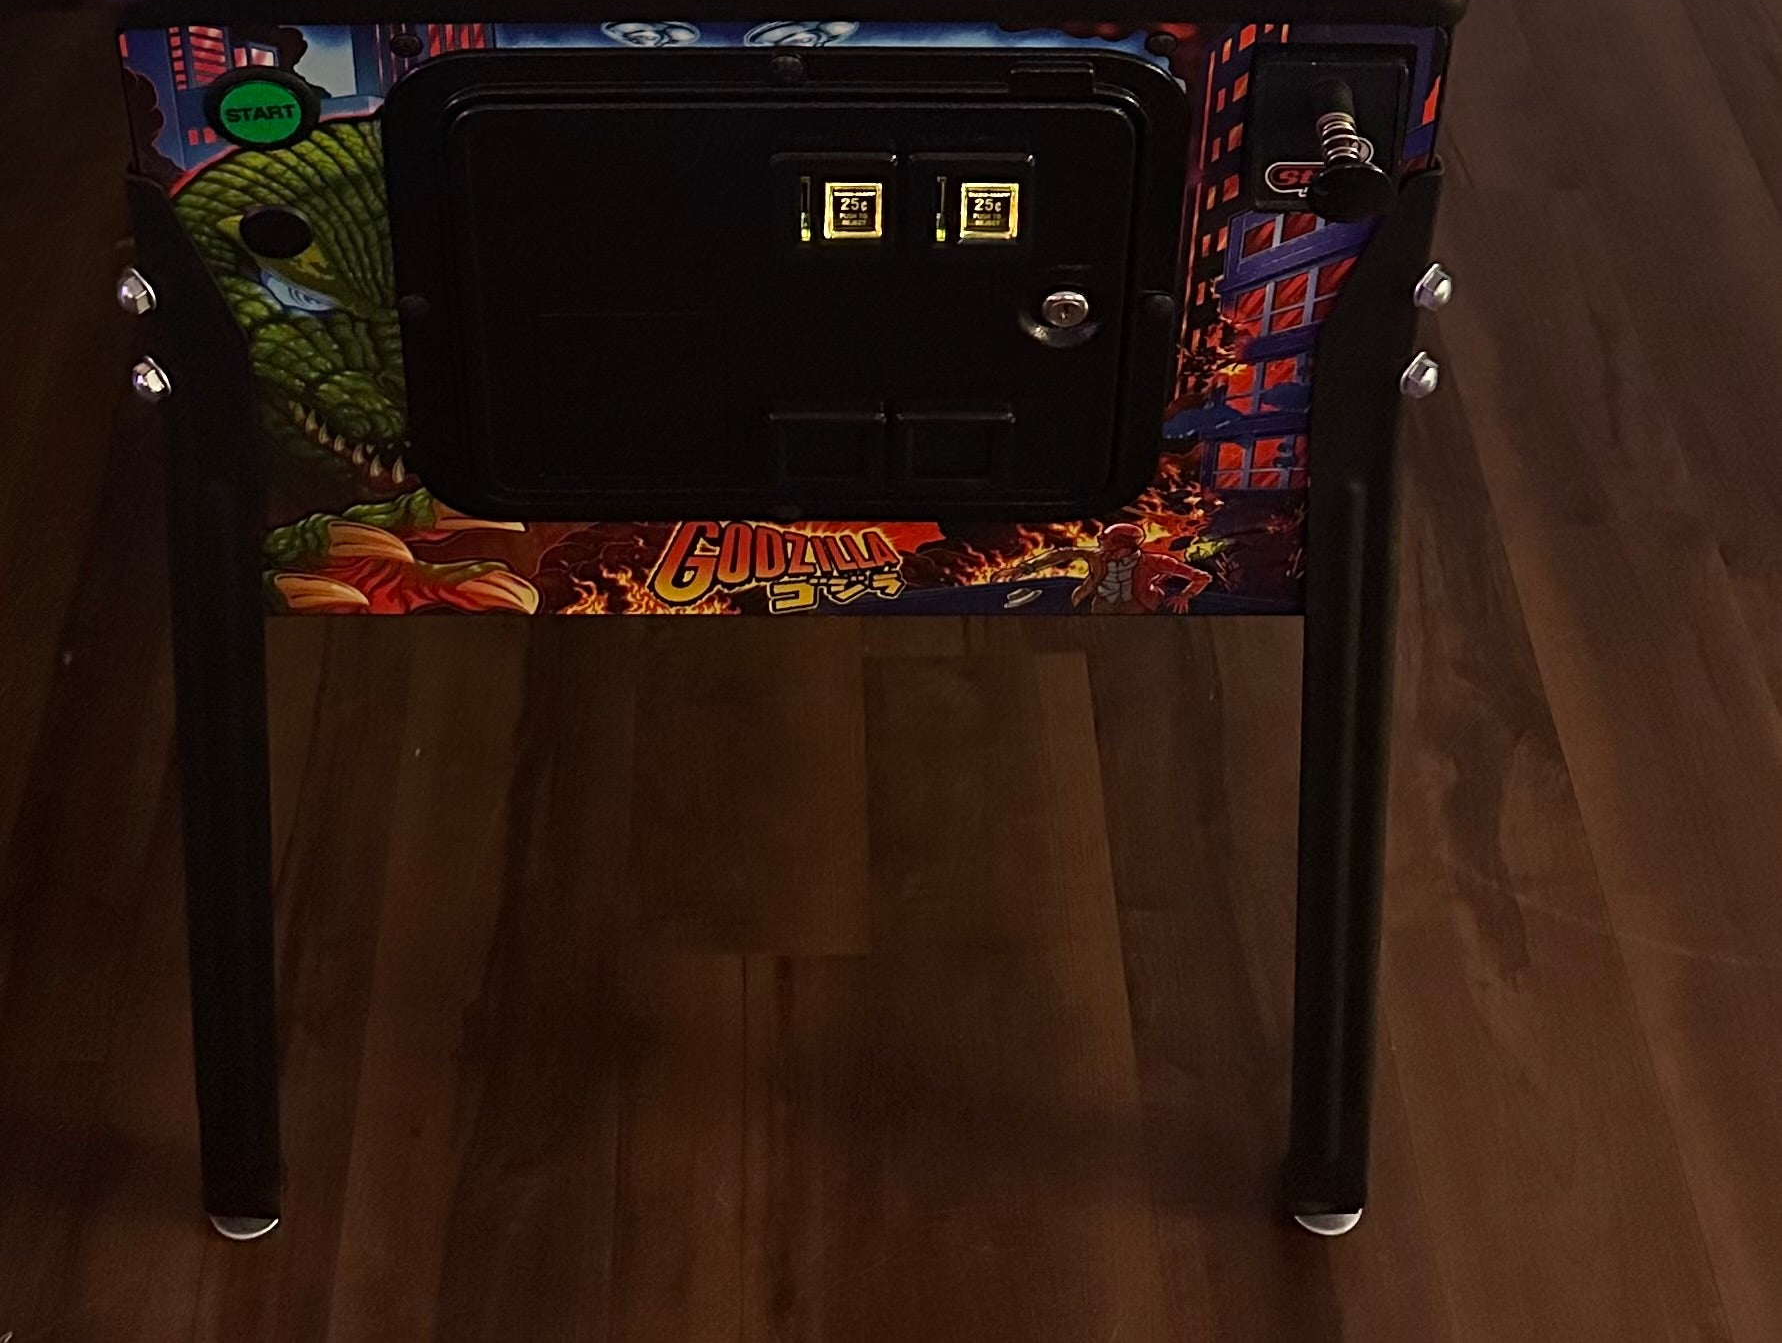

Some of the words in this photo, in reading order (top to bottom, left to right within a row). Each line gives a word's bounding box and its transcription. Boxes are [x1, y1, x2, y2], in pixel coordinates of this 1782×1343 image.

[225, 103, 296, 123] START
[840, 197, 868, 212] 25¢
[974, 197, 1002, 212] 25¢
[654, 521, 899, 603] GODZILLA
[772, 573, 902, 611] ゴジラ
